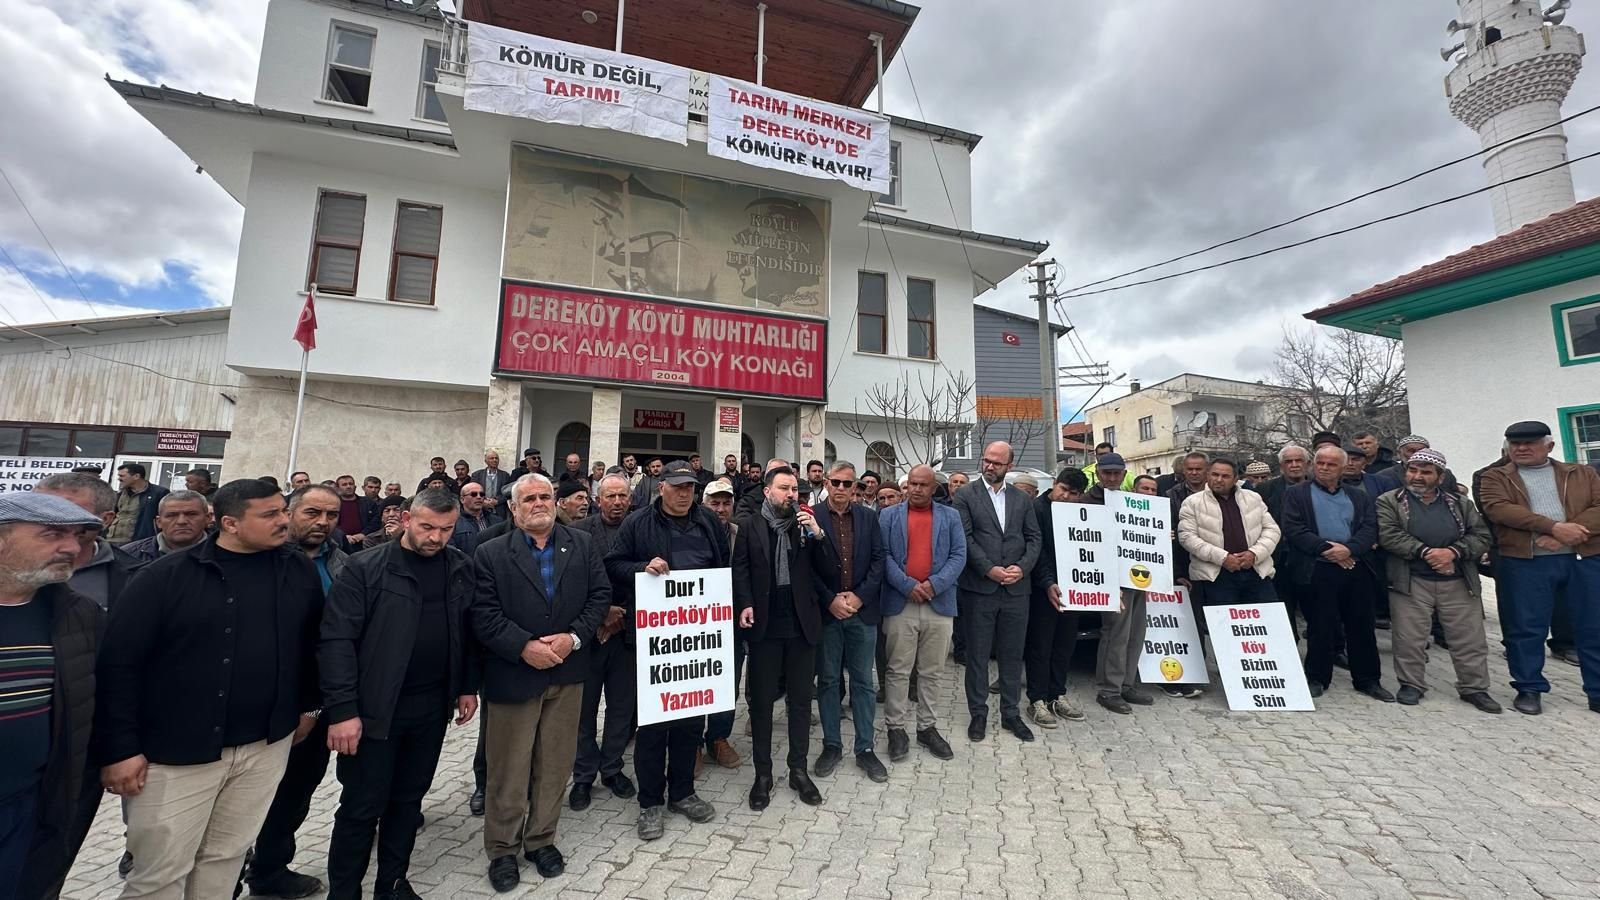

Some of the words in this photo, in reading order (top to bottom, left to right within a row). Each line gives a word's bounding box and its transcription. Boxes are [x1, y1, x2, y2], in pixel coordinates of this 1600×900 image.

[499, 45, 586, 75] KÖMÜR
[592, 64, 662, 93] DEĞİL,
[543, 77, 621, 103] TARIM!
[728, 88, 788, 115] TARIM
[793, 104, 872, 141] MERKEZİ
[742, 114, 859, 158] DEREKÖY'DE
[726, 134, 808, 165] KÖMÜRE
[812, 156, 872, 181] HAYIR!
[511, 292, 621, 328] DEREKÖY
[627, 305, 685, 336] KÖYÜ
[692, 316, 818, 352] MUHTARLIĞI
[511, 331, 569, 354] ÇOK
[575, 337, 669, 366] AMAÇLI
[677, 346, 724, 369] KÖY
[730, 354, 813, 379] KONAĞI
[656, 372, 685, 381] 2004
[644, 410, 674, 418] MARKET
[1124, 496, 1150, 511] Yeşil
[1079, 507, 1087, 521] O
[1128, 513, 1150, 527] Arar
[1152, 517, 1164, 530] La
[1068, 527, 1102, 542] Kadın
[1122, 529, 1156, 545] Kömür
[1079, 548, 1095, 563] Bu
[1072, 568, 1104, 585] Ocağı
[665, 579, 695, 598] Dur
[699, 578, 704, 595] !
[1068, 589, 1110, 607] Kapatır
[636, 602, 732, 629] Dereköy'ün
[1229, 608, 1260, 620] Dere
[1231, 624, 1268, 637] Bizim
[649, 630, 722, 656] Kaderini
[1143, 640, 1189, 656] Beyler
[1241, 641, 1266, 654] Köy
[650, 658, 723, 685] Kömürle
[1240, 659, 1278, 671] Bizim
[1241, 676, 1286, 689] Kömür
[660, 688, 714, 712] Yazma
[1253, 694, 1286, 708] Sizin
